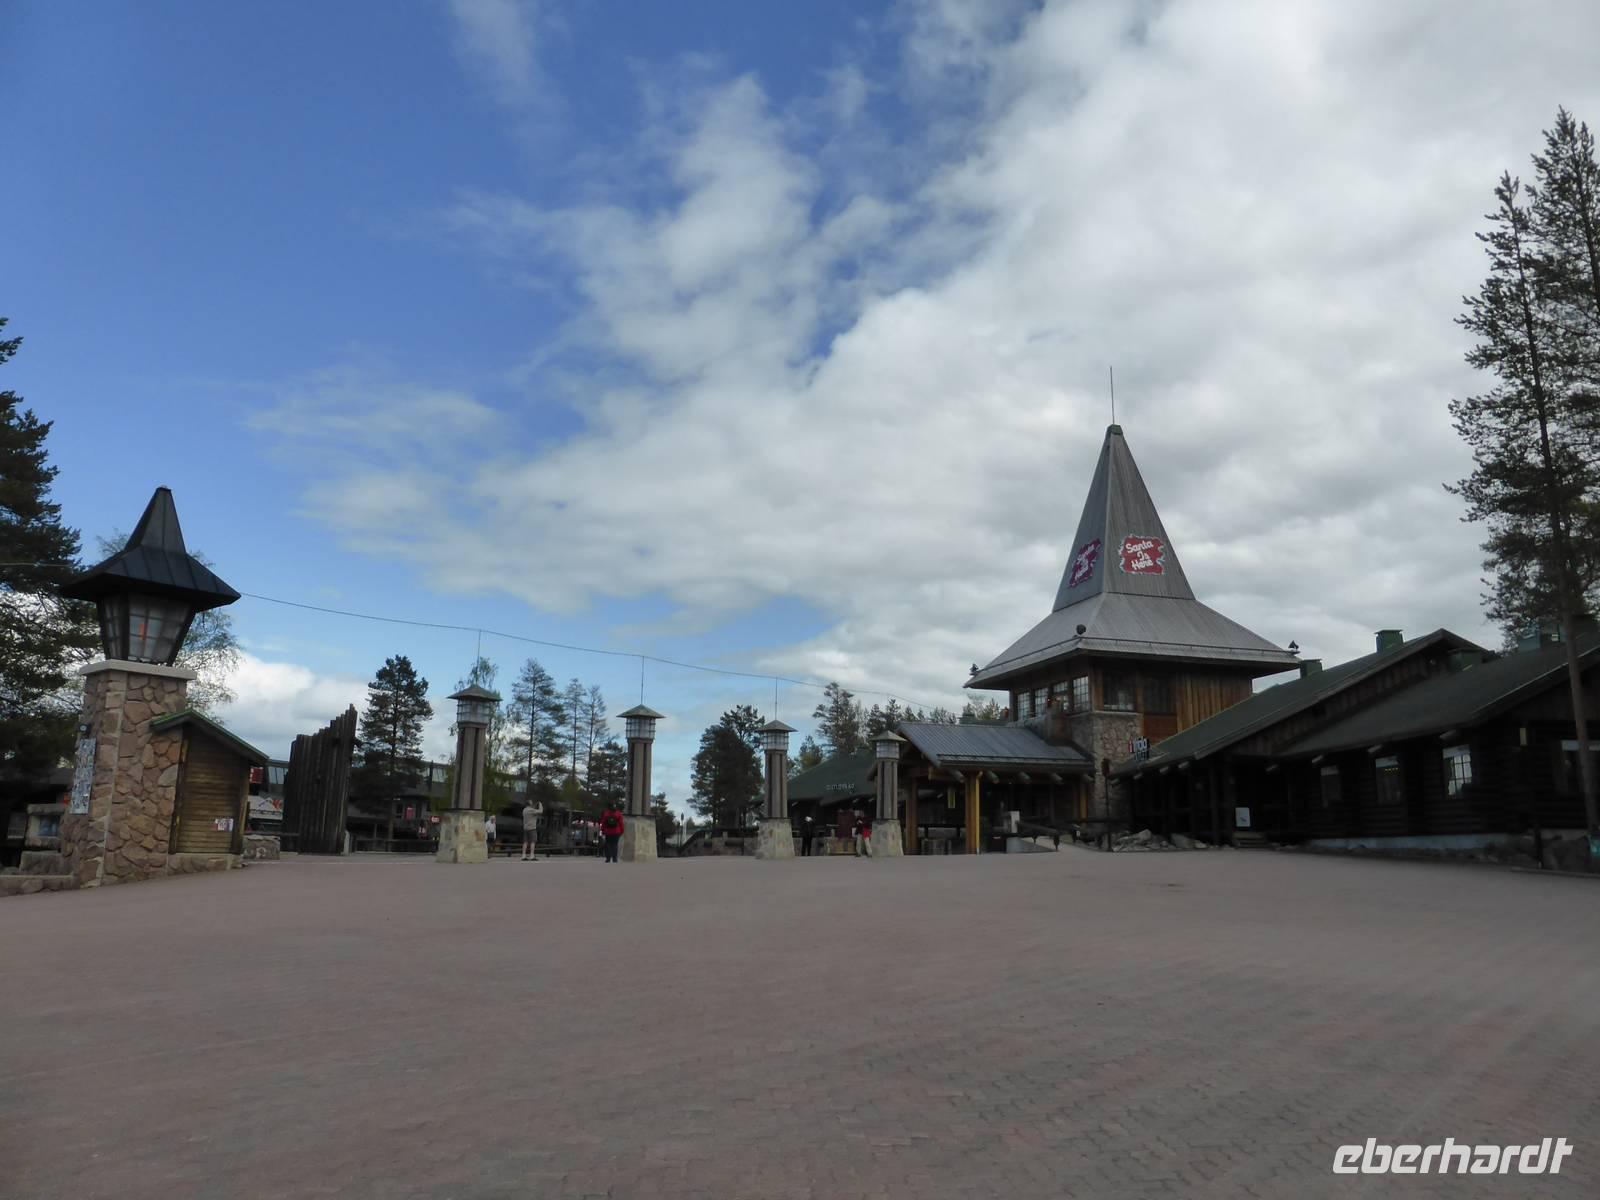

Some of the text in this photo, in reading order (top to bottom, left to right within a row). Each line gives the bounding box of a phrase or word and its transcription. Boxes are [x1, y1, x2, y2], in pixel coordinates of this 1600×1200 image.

[1125, 540, 1154, 554] Santa
[1137, 551, 1151, 561] Is
[1131, 559, 1154, 571] Here
